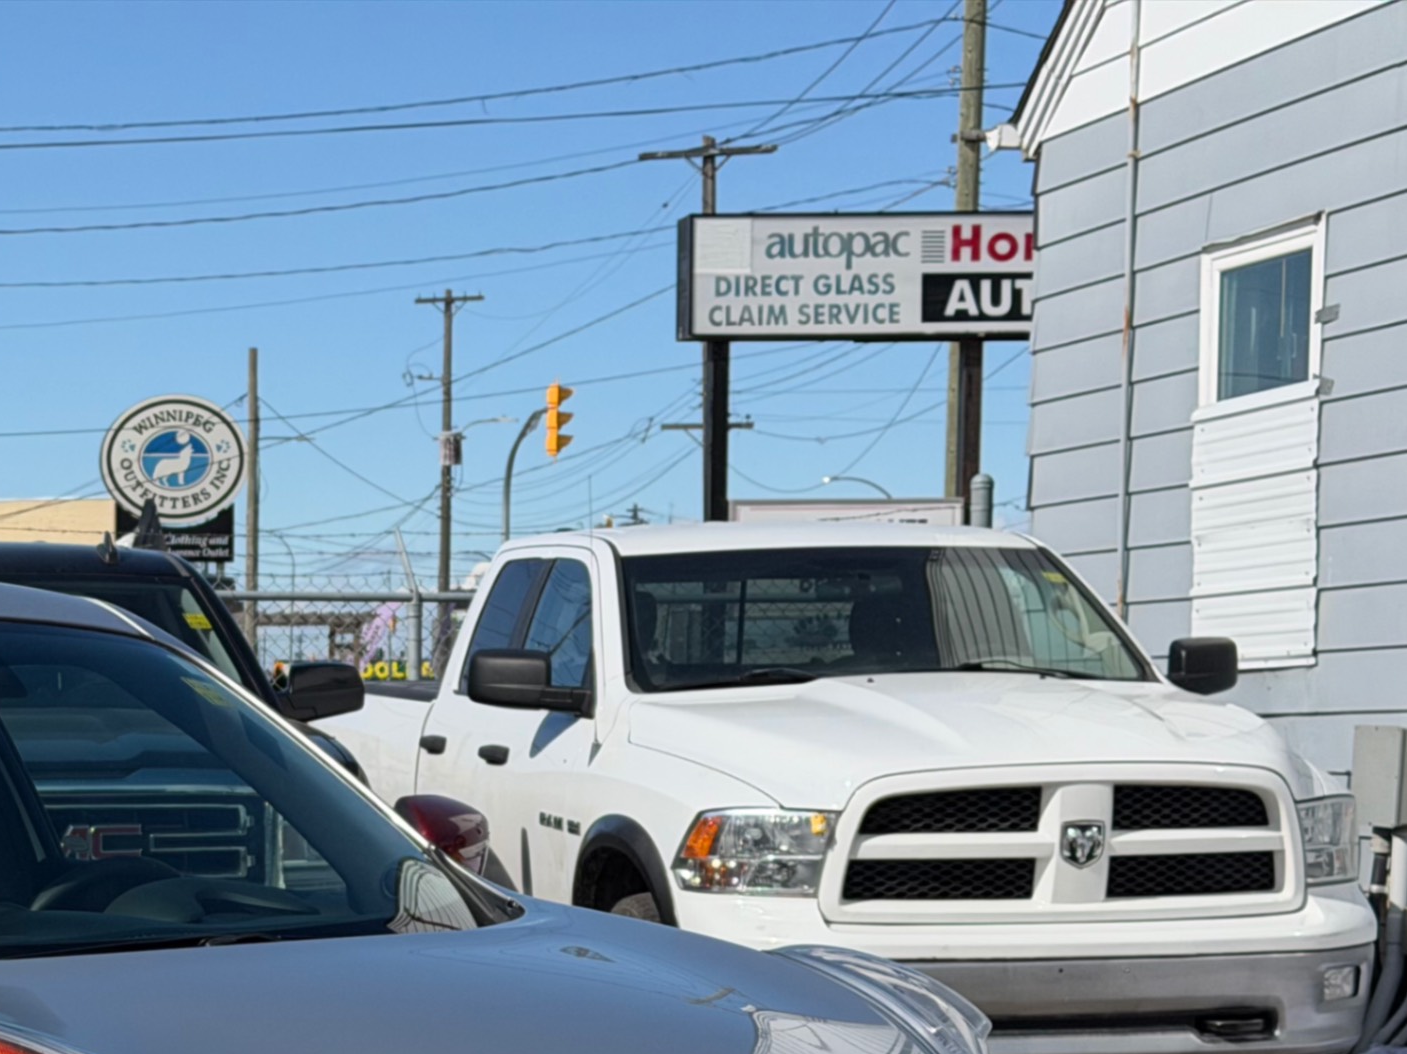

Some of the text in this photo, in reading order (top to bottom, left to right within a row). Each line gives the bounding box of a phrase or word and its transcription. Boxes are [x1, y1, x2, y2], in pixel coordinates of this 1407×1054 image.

[764, 225, 911, 271] autopac
[714, 273, 896, 298] DIRECT GLASS
[707, 302, 901, 327] CLAIM SERVICE
[132, 409, 216, 436] WINNIPEG
